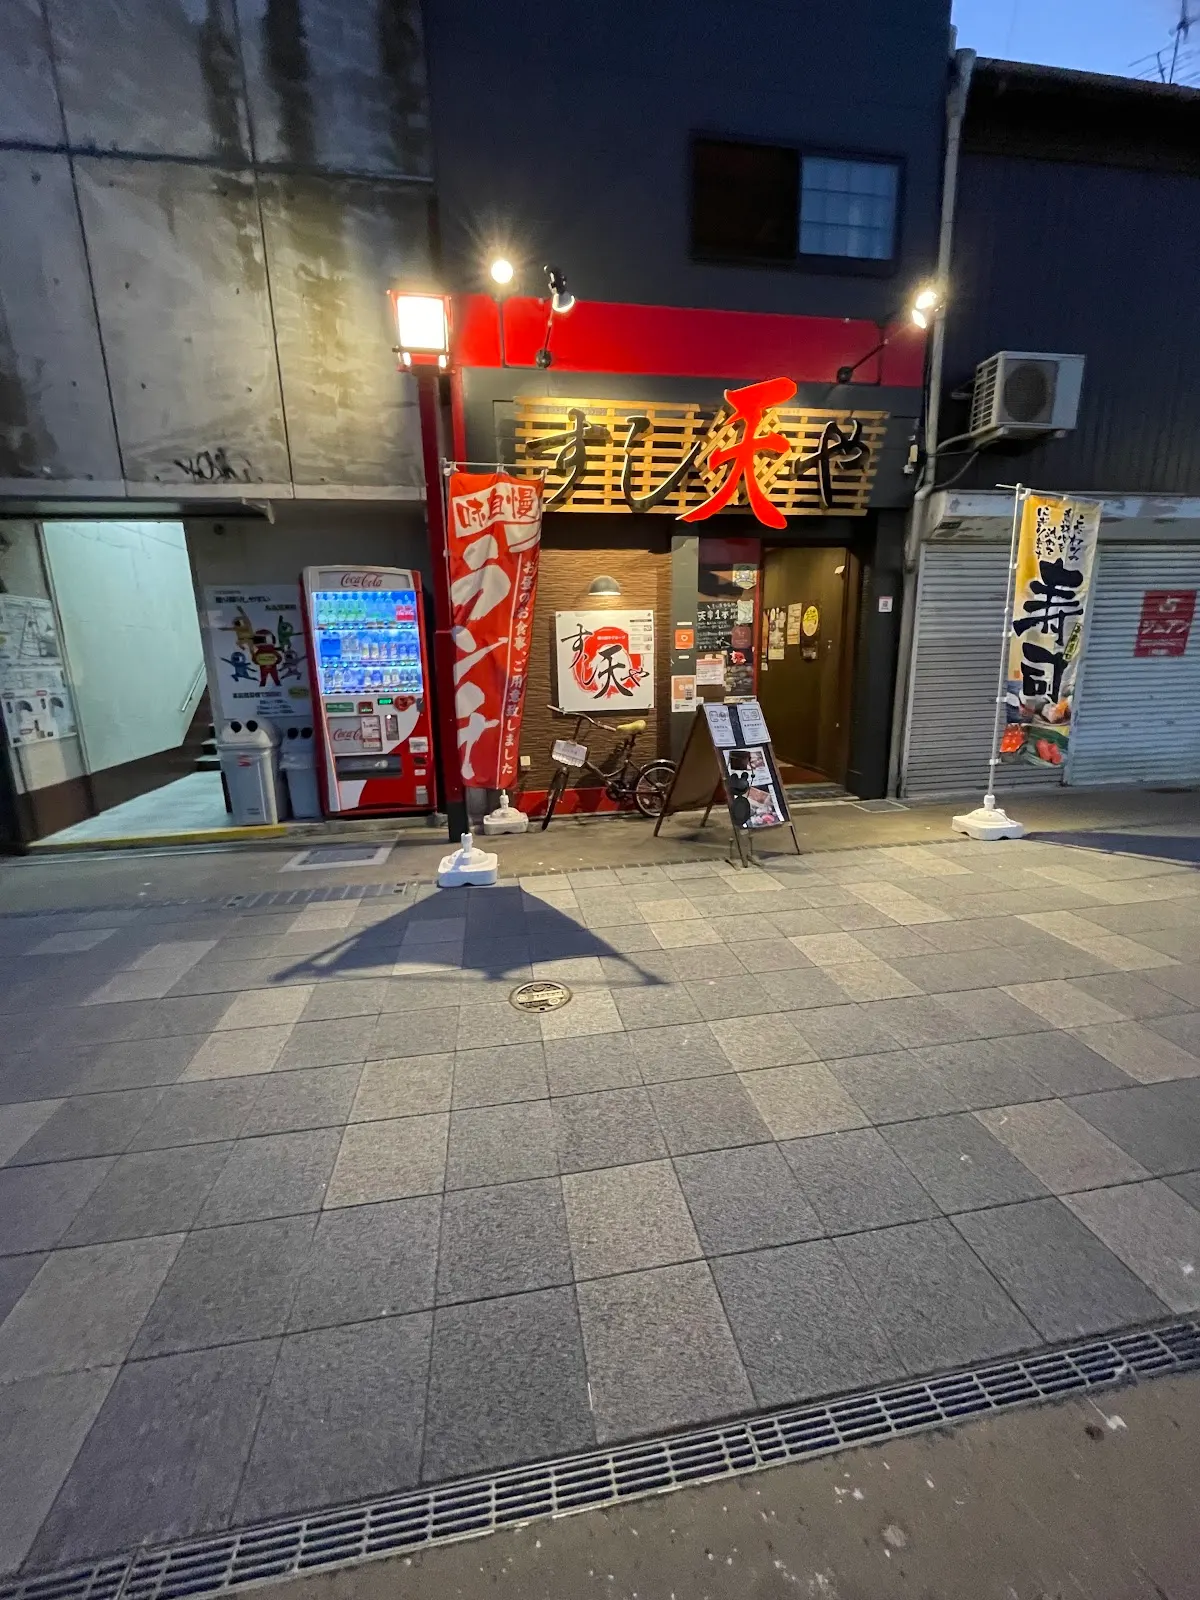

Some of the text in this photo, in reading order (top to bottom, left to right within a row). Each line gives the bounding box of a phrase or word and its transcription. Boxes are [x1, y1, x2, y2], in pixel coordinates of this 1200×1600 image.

[455, 487, 539, 528] 味自慢
[1034, 506, 1050, 560] にぎります
[1068, 514, 1085, 561] こだわりの
[450, 533, 514, 780] ランチ
[560, 622, 650, 700] すし天や
[1012, 557, 1084, 704] 寿司
